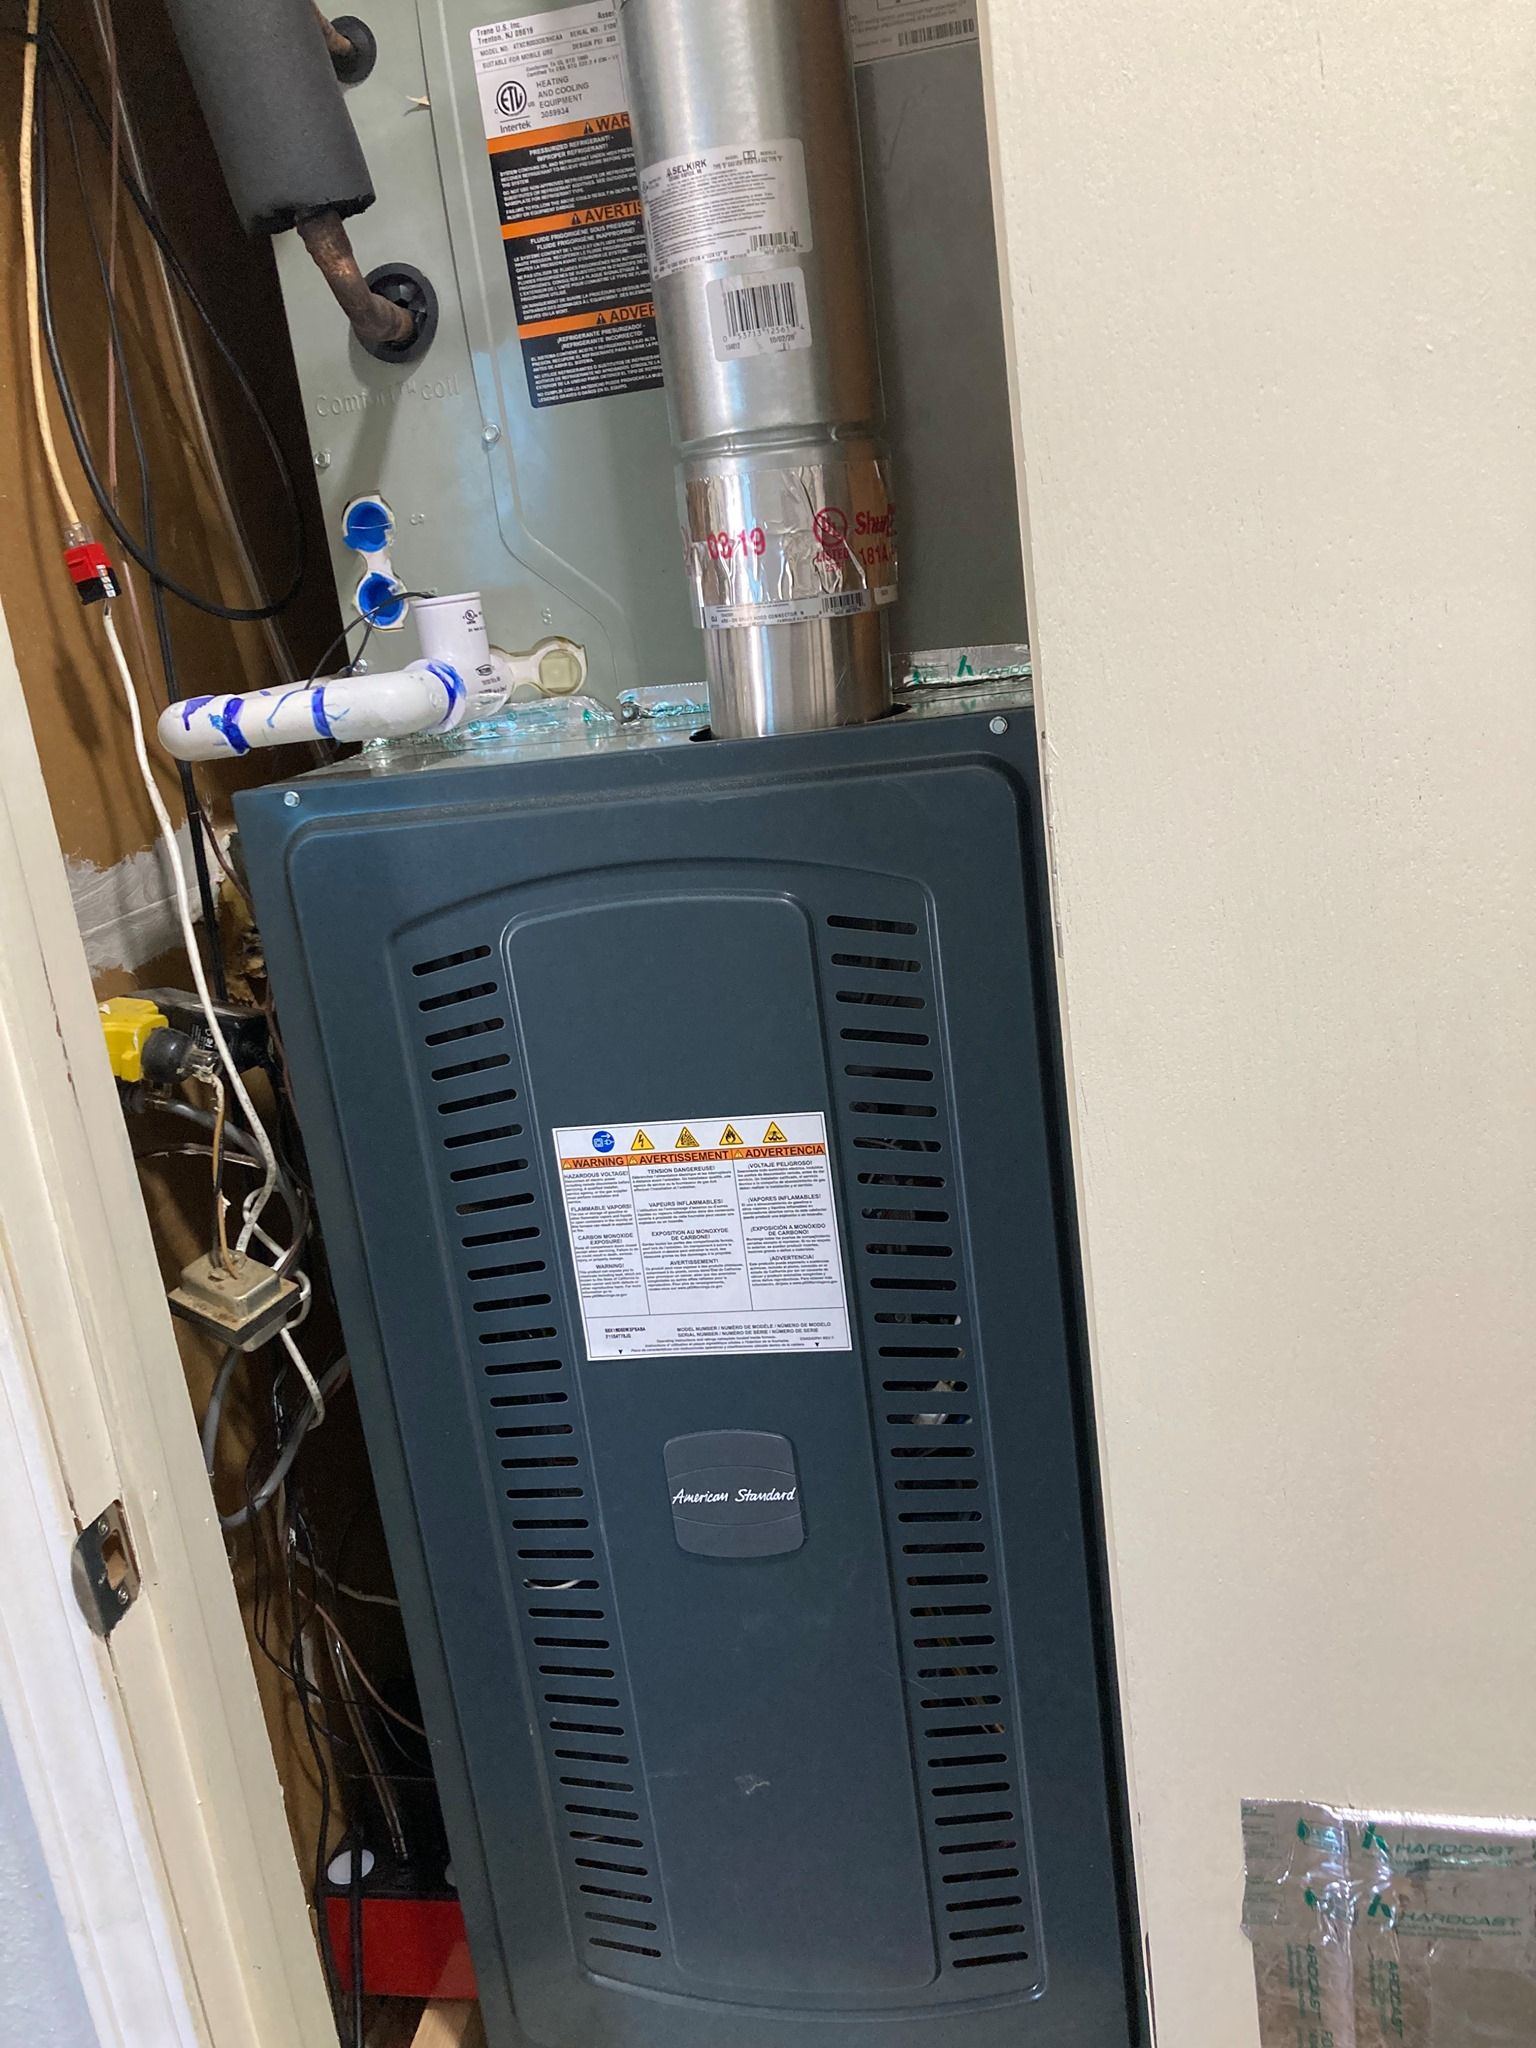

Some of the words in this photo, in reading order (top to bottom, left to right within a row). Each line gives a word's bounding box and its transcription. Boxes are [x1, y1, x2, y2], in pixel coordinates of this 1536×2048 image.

[477, 27, 493, 36] Trane
[496, 24, 509, 32] U.S.
[510, 21, 521, 29] Inc.
[478, 34, 503, 44] Trenton,
[480, 48, 497, 56] MODEL
[482, 58, 506, 68] SUITABLE
[521, 51, 540, 60] MOBILE
[536, 76, 568, 88] HEATING
[537, 89, 553, 98] AND
[554, 82, 589, 95] COOLING
[539, 93, 582, 108] EQUIPMENT
[500, 120, 531, 133] Intertek
[672, 159, 708, 176] SELKIRK
[737, 330, 762, 340] 53713
[572, 1157, 624, 1168] WARNING
[639, 1151, 729, 1164] AVERTISSEMENT
[745, 1145, 824, 1158] ADVERTENCIA
[671, 1487, 730, 1505] American
[734, 1486, 798, 1503] Standard
[1395, 1843, 1515, 1857] HARDCAST
[1401, 1911, 1521, 1928] HARDCAST
